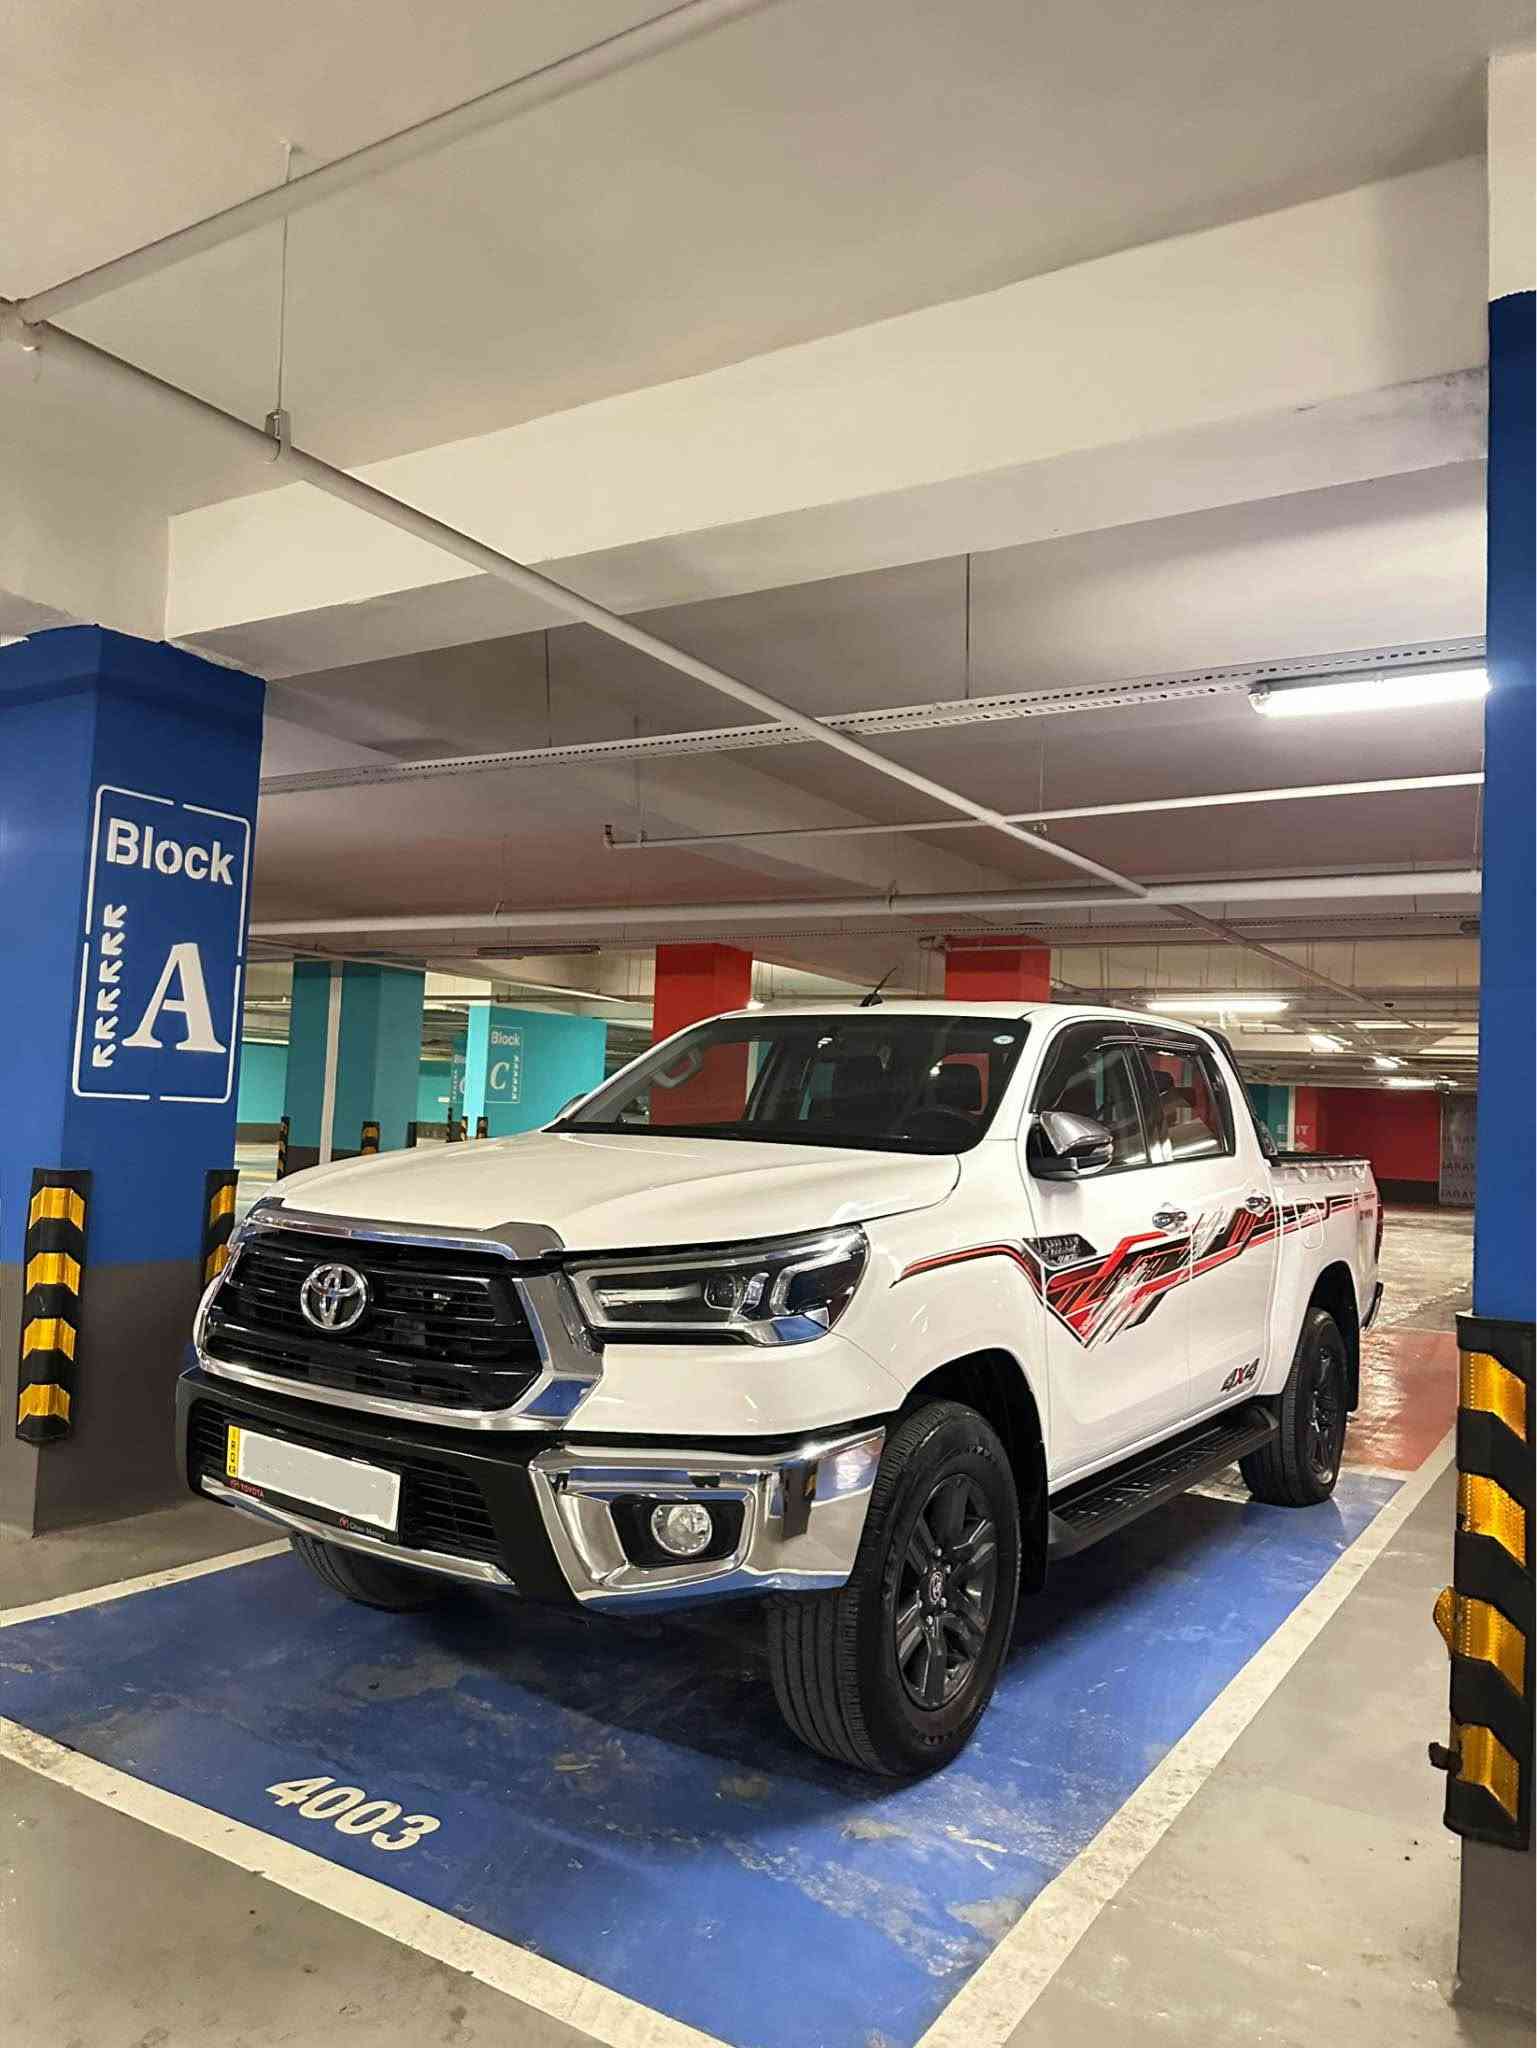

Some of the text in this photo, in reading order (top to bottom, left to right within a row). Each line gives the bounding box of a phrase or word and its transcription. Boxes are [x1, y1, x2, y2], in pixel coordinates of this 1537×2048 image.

[105, 816, 235, 886] Block
[121, 942, 227, 1054] A
[490, 1031, 521, 1047] Block
[489, 1060, 510, 1091] C
[265, 1776, 441, 1851] 4003
